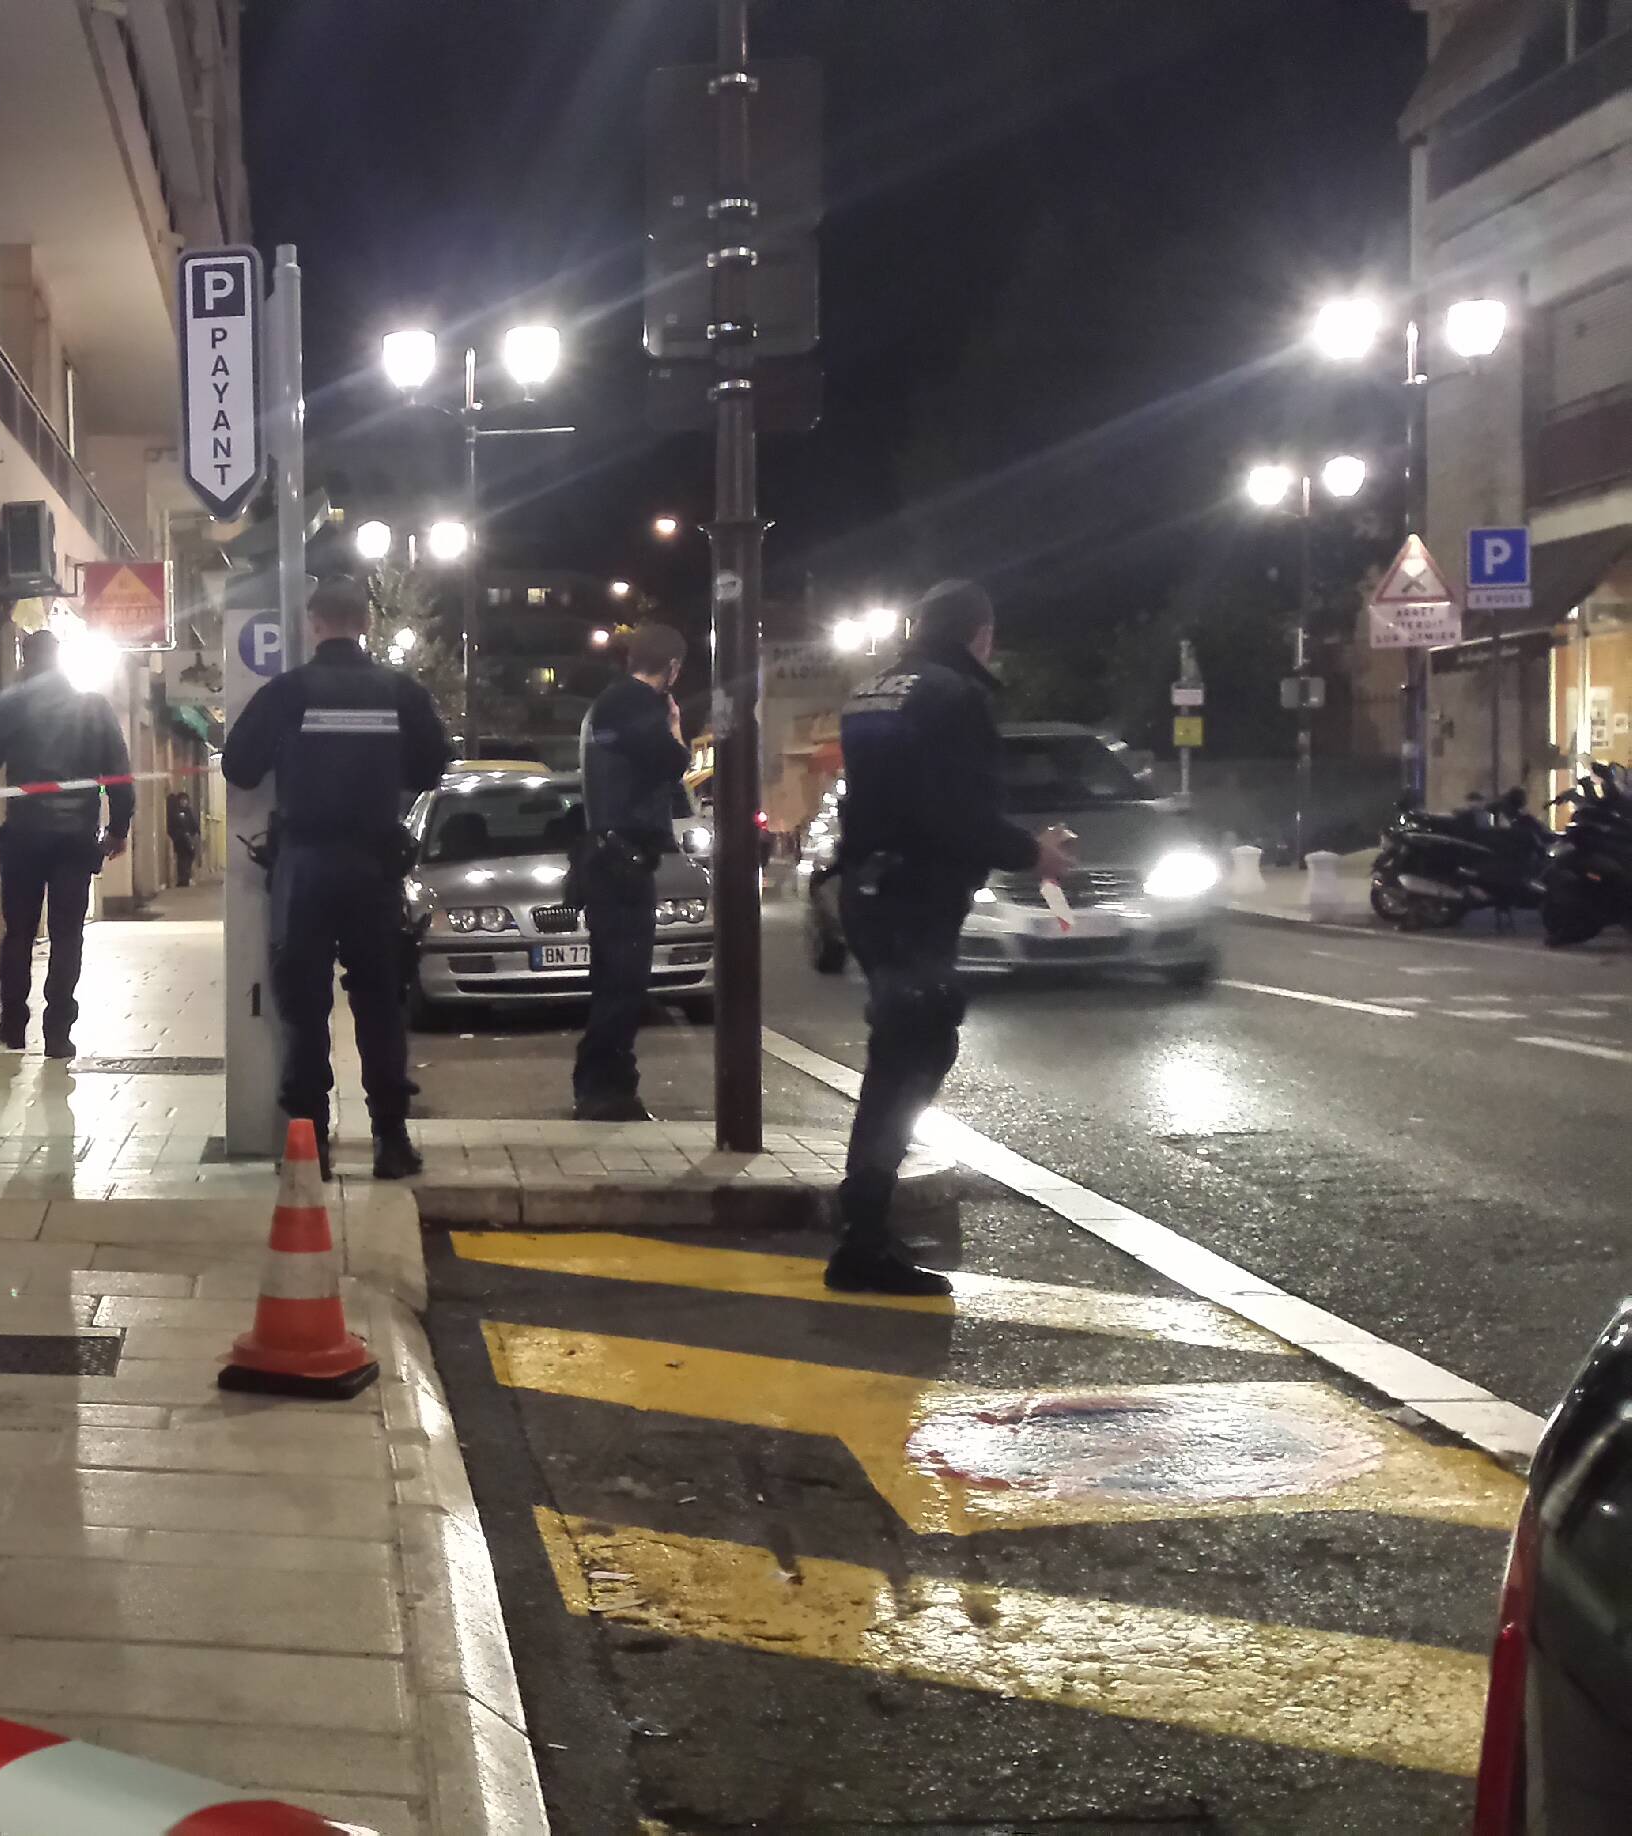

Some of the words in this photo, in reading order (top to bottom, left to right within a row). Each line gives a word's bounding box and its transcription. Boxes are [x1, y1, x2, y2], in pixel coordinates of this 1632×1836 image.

[204, 270, 235, 311] P
[210, 327, 232, 486] PAYANT
[1484, 538, 1512, 576] P
[253, 622, 282, 666] P
[545, 948, 565, 963] BN
